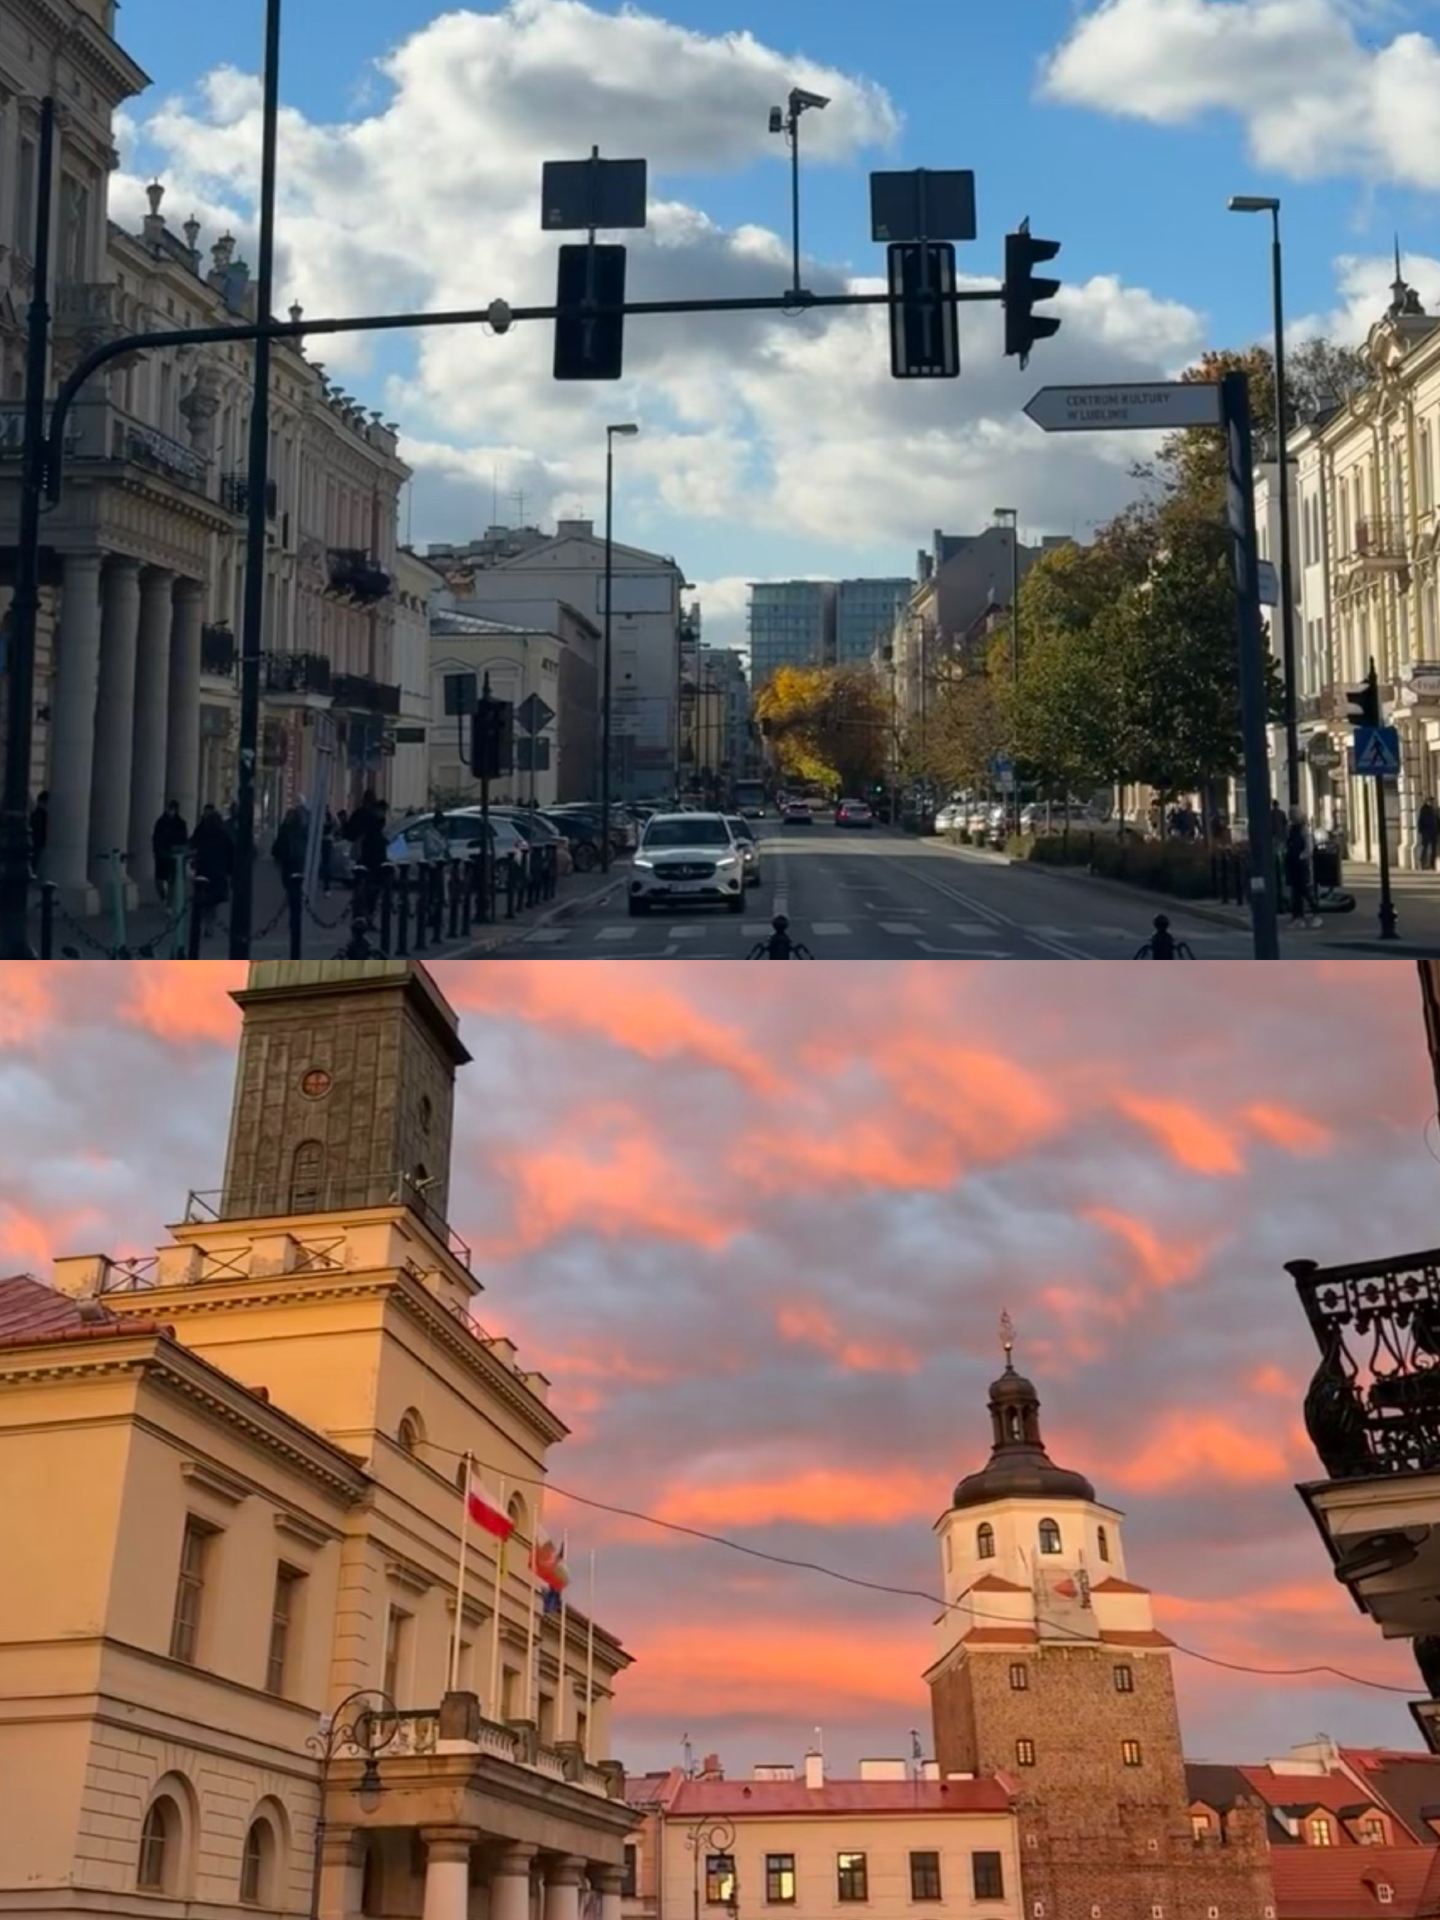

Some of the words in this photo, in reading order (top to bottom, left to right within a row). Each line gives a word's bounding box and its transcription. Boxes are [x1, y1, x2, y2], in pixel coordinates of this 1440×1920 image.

[1066, 394, 1118, 406] CENTRUM
[1121, 391, 1170, 404] KULTURY
[1067, 410, 1077, 420] W
